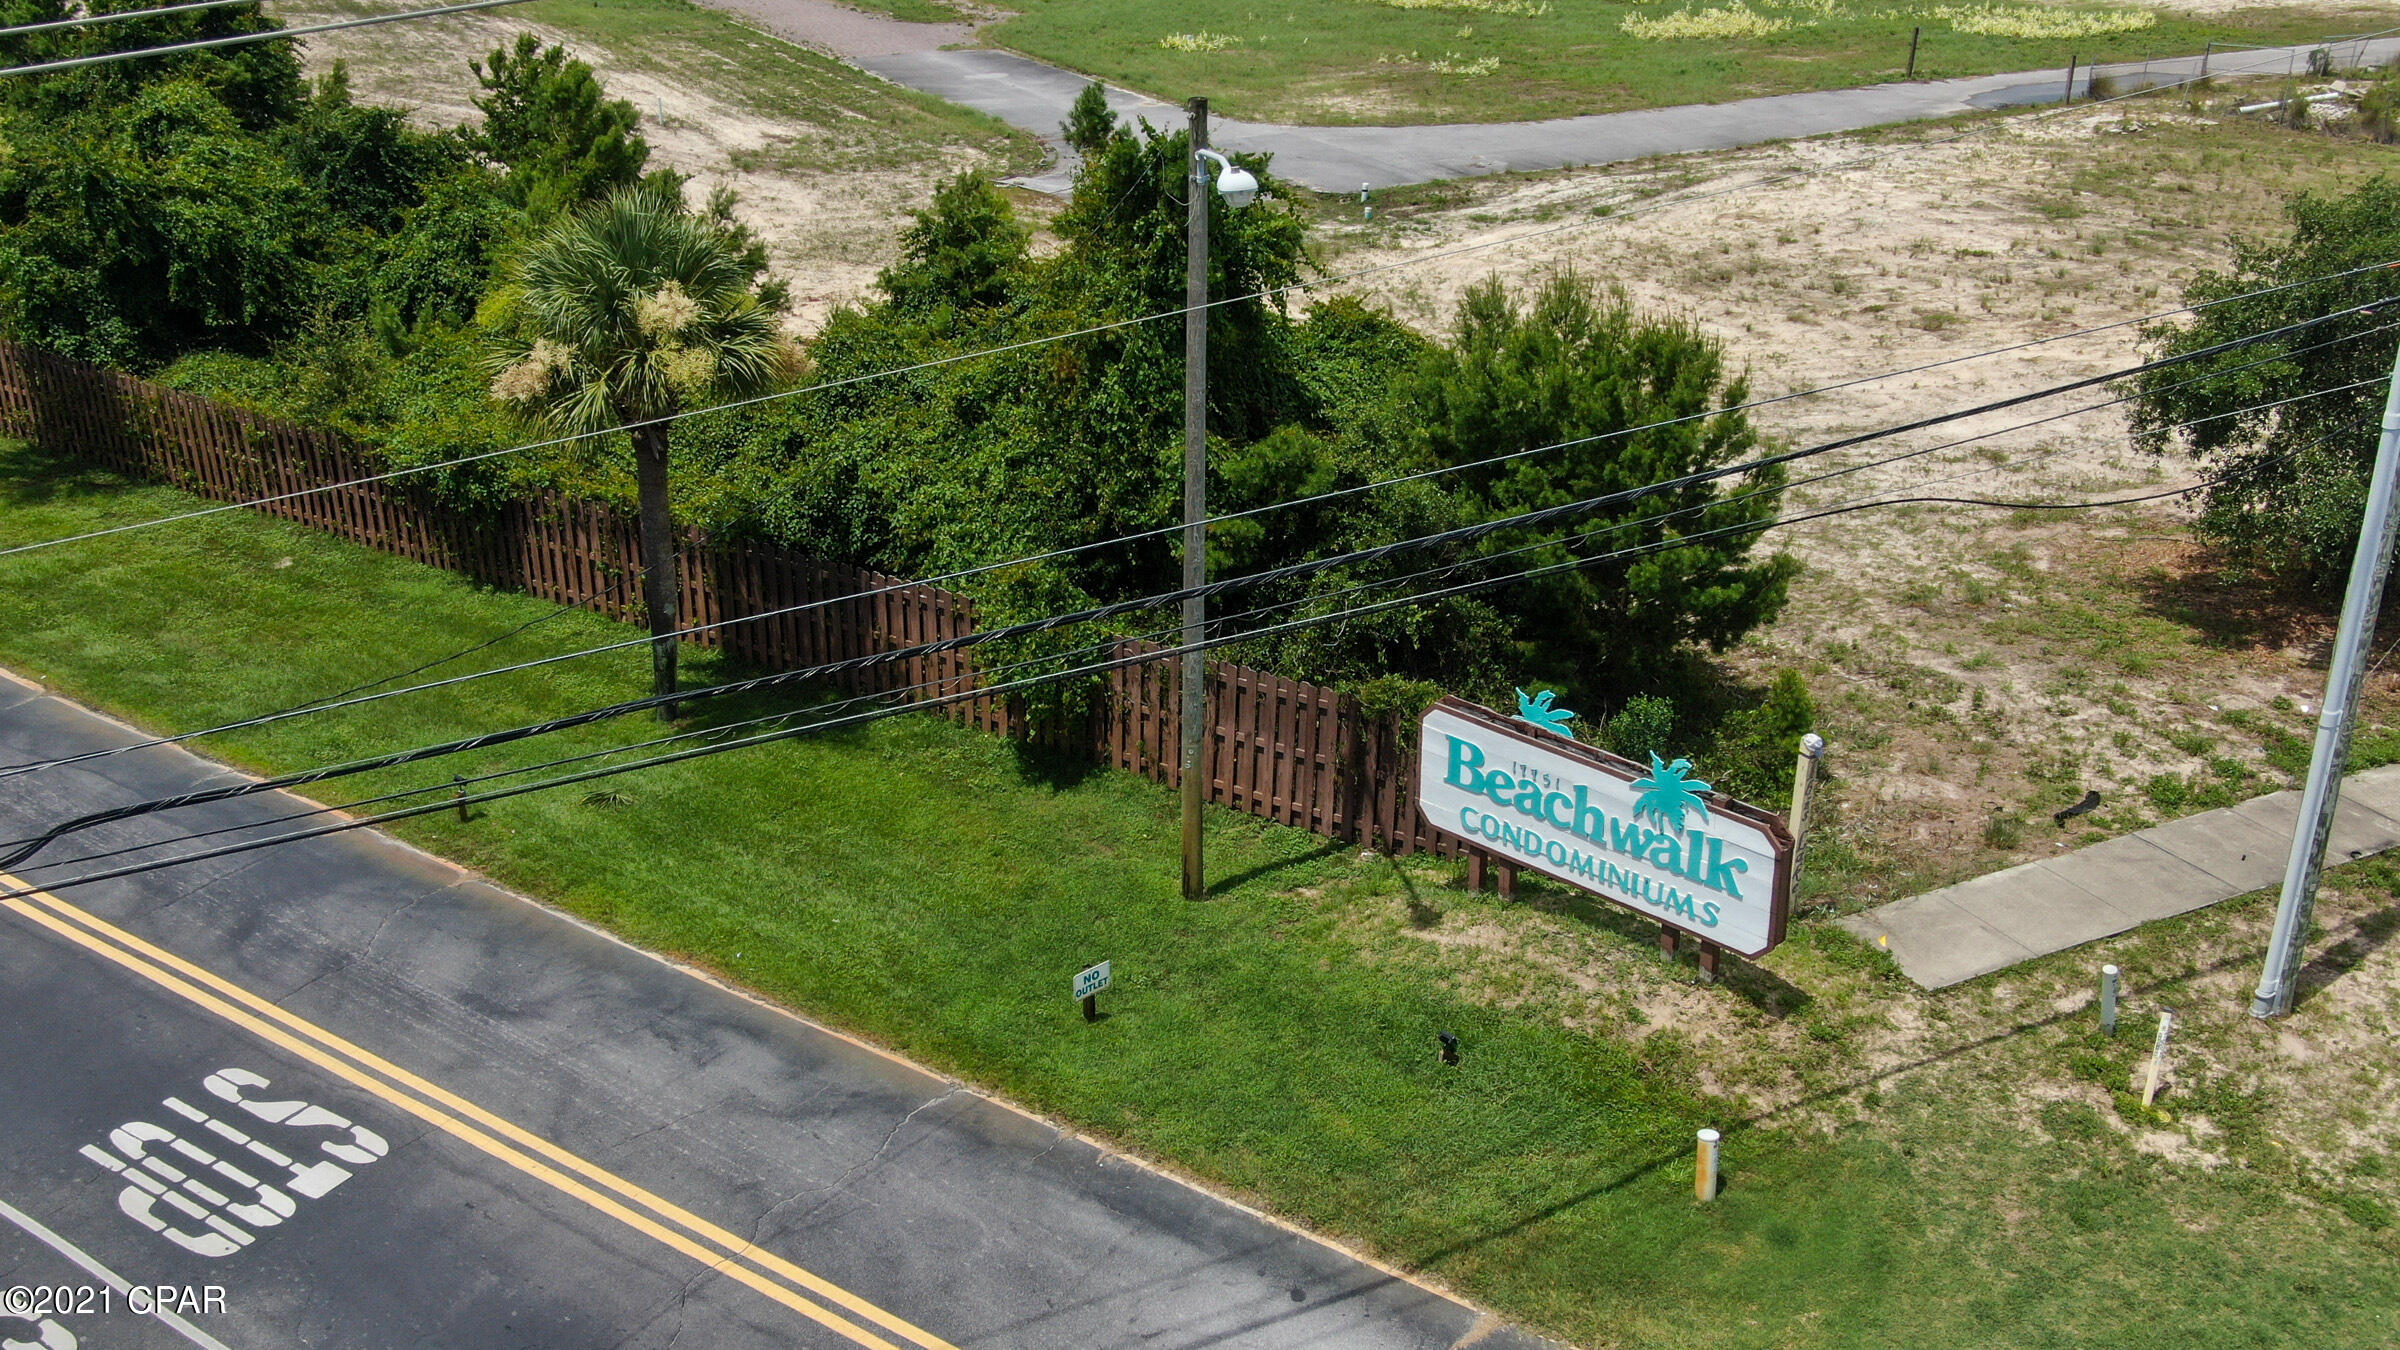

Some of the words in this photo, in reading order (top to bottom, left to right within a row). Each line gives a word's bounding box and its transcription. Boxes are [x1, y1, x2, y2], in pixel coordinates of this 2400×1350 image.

[1512, 761, 1560, 791] 17751
[1444, 735, 1748, 900] Beachwalk
[1460, 806, 1721, 927] CONDOMINIUMS
[1075, 976, 1109, 998] OUTLET
[1083, 970, 1100, 985] NO
[80, 1068, 389, 1257] STOP
